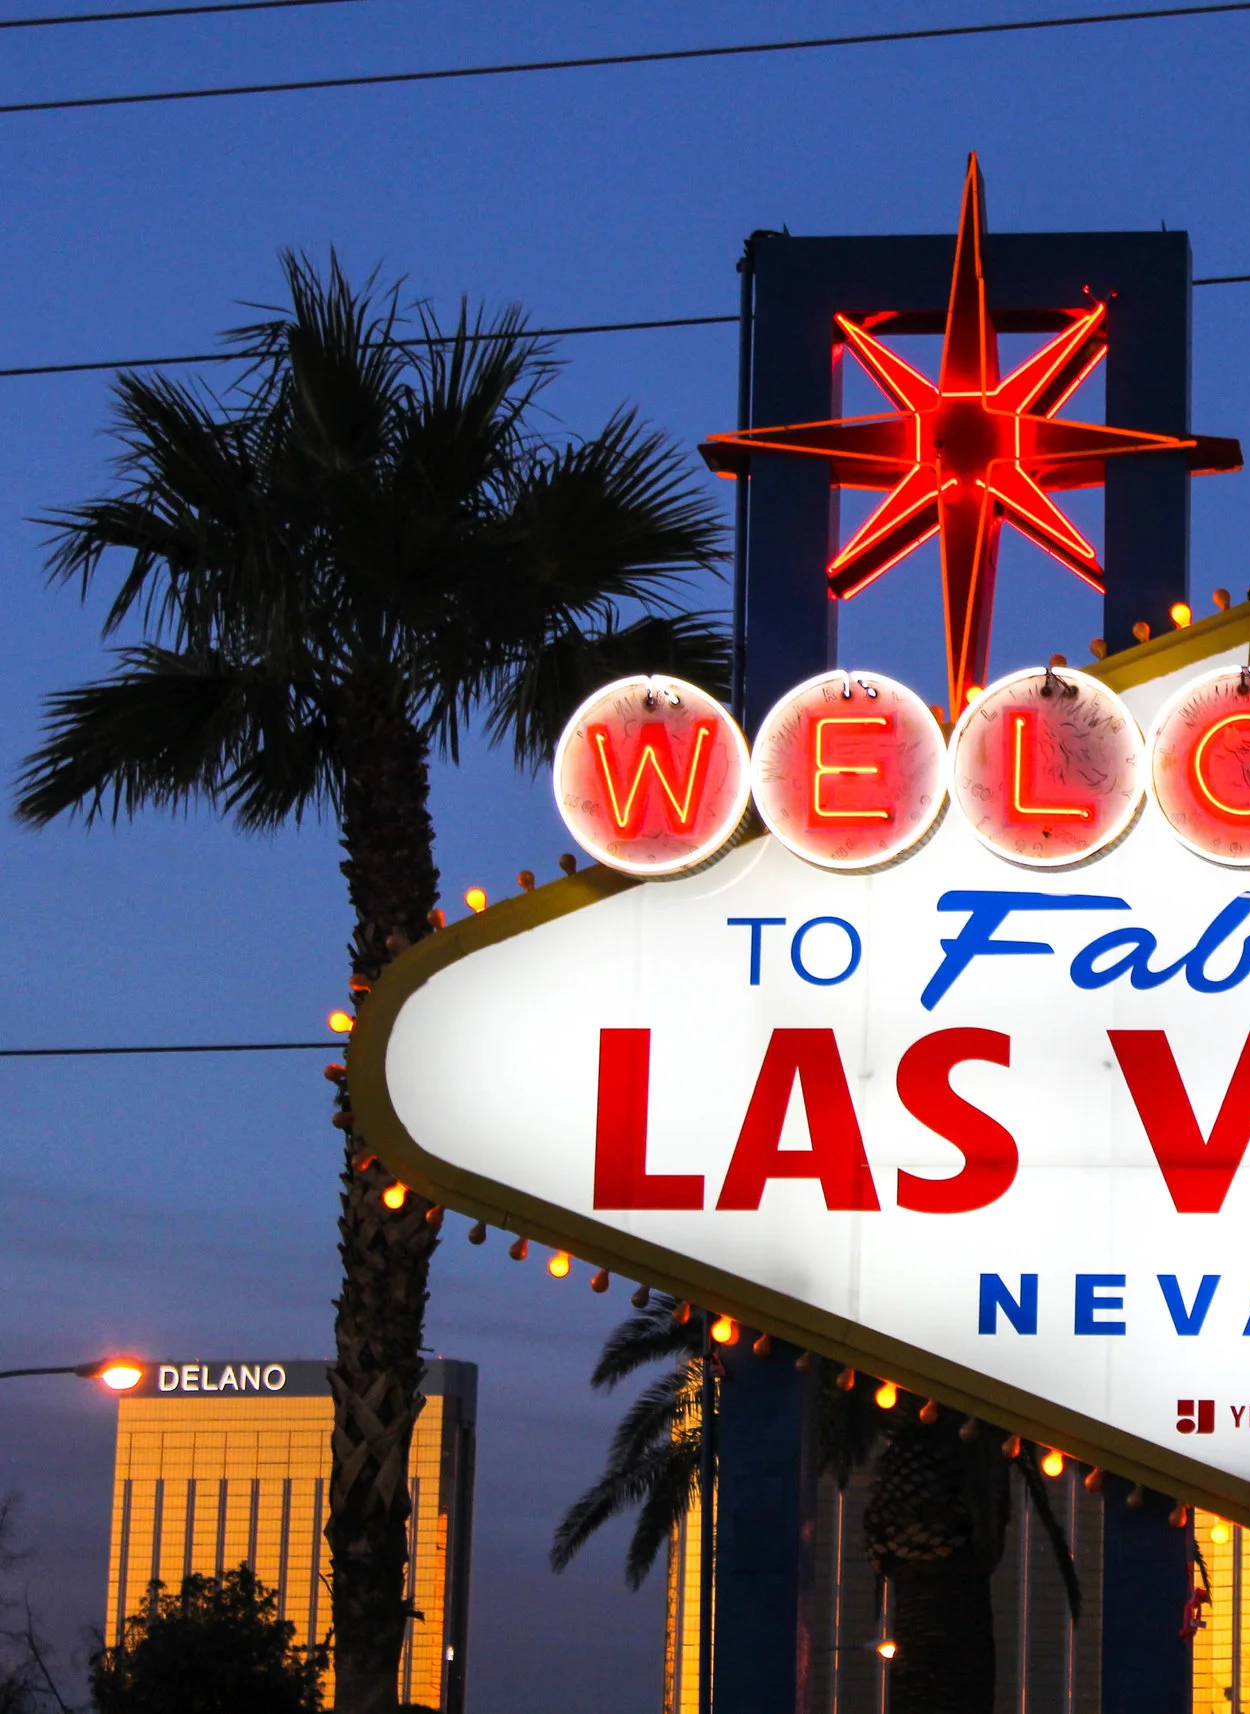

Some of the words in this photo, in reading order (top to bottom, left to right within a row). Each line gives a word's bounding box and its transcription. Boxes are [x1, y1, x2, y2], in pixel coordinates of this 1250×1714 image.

[727, 915, 861, 986] TO
[593, 1026, 1019, 1214] LAS
[158, 1364, 286, 1391] DELANO
